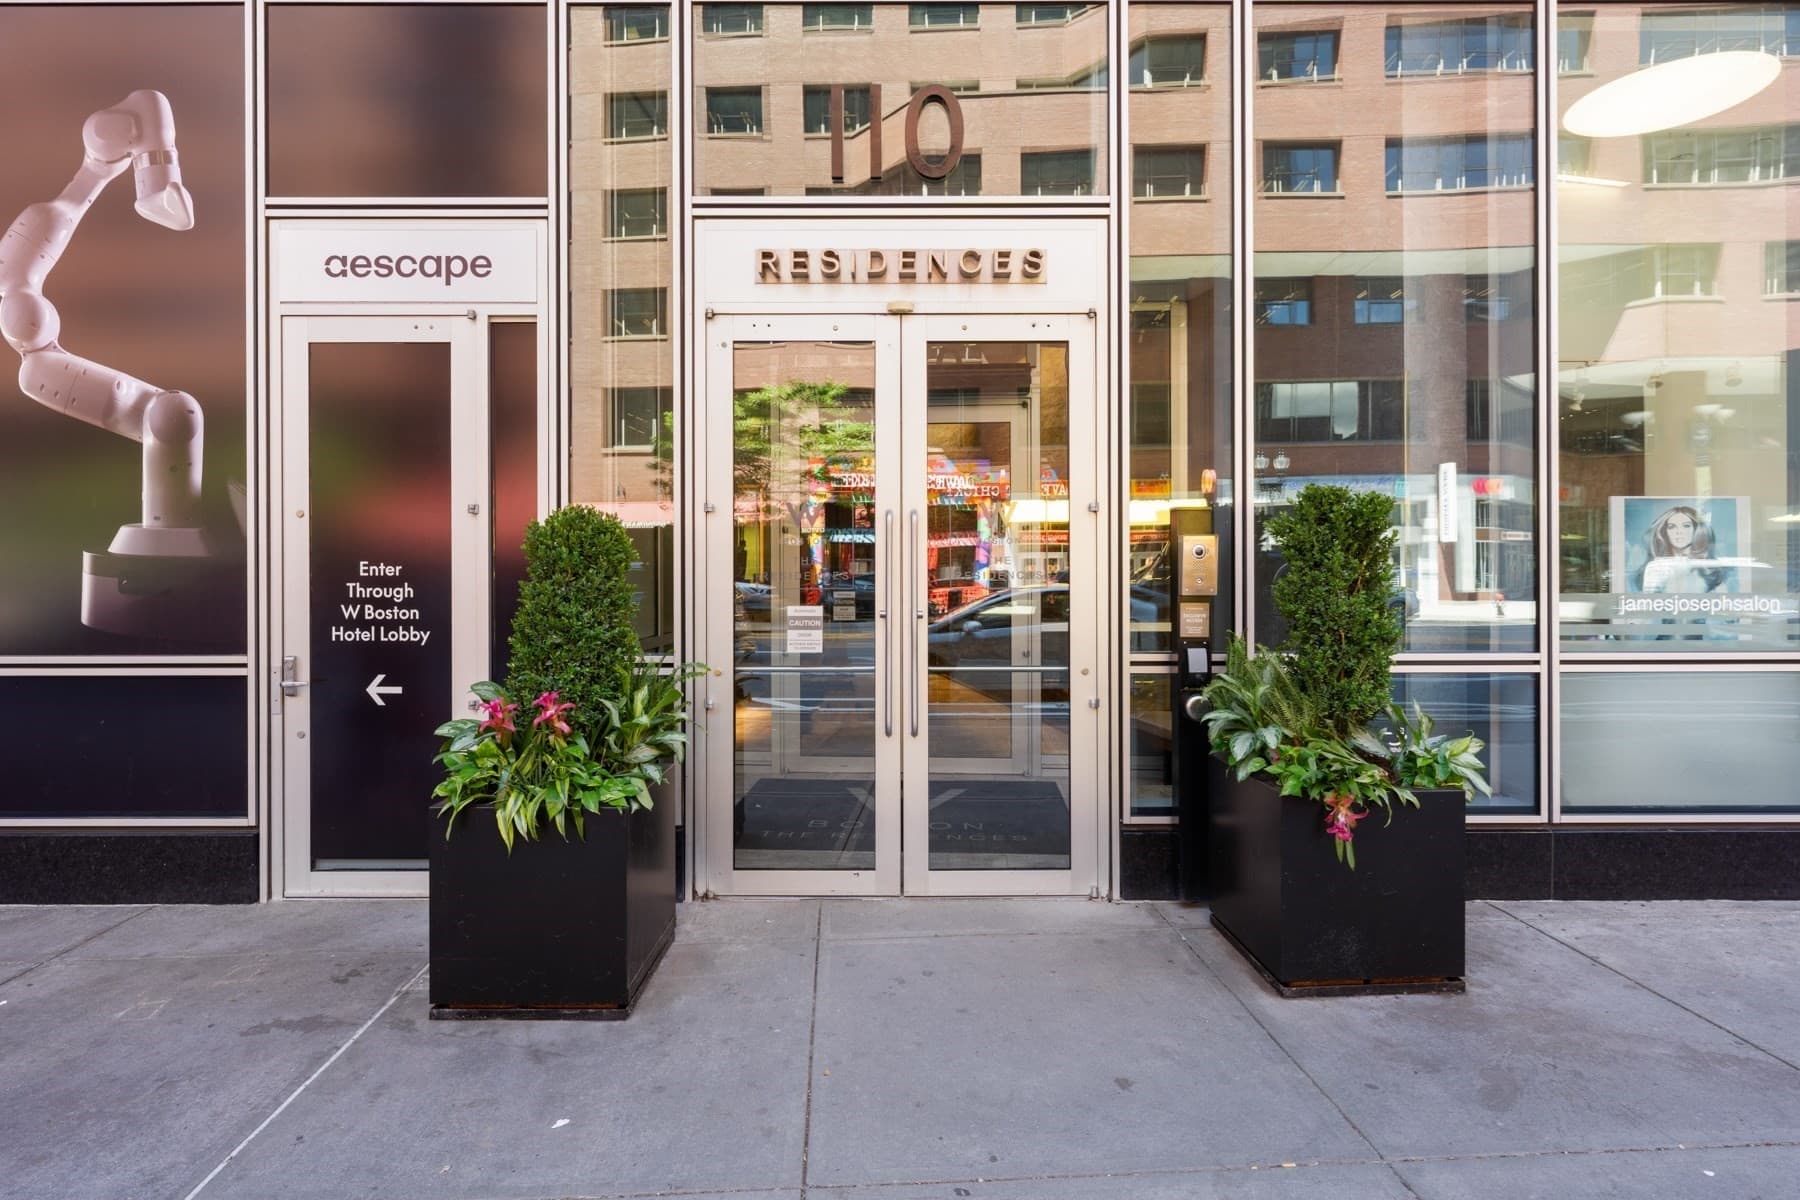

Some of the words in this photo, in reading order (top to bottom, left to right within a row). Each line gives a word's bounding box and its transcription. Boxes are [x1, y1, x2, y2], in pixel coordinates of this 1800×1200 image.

[830, 84, 964, 182] 110
[324, 255, 493, 286] aescape
[758, 249, 1045, 279] RESIDENCES
[359, 561, 402, 576] Enter
[346, 582, 414, 602] Through
[340, 604, 360, 620] W
[364, 604, 419, 620] Boston
[1618, 595, 1781, 615] jamesjosephsalon
[332, 626, 375, 642] Hotel
[380, 626, 431, 646] Lobby
